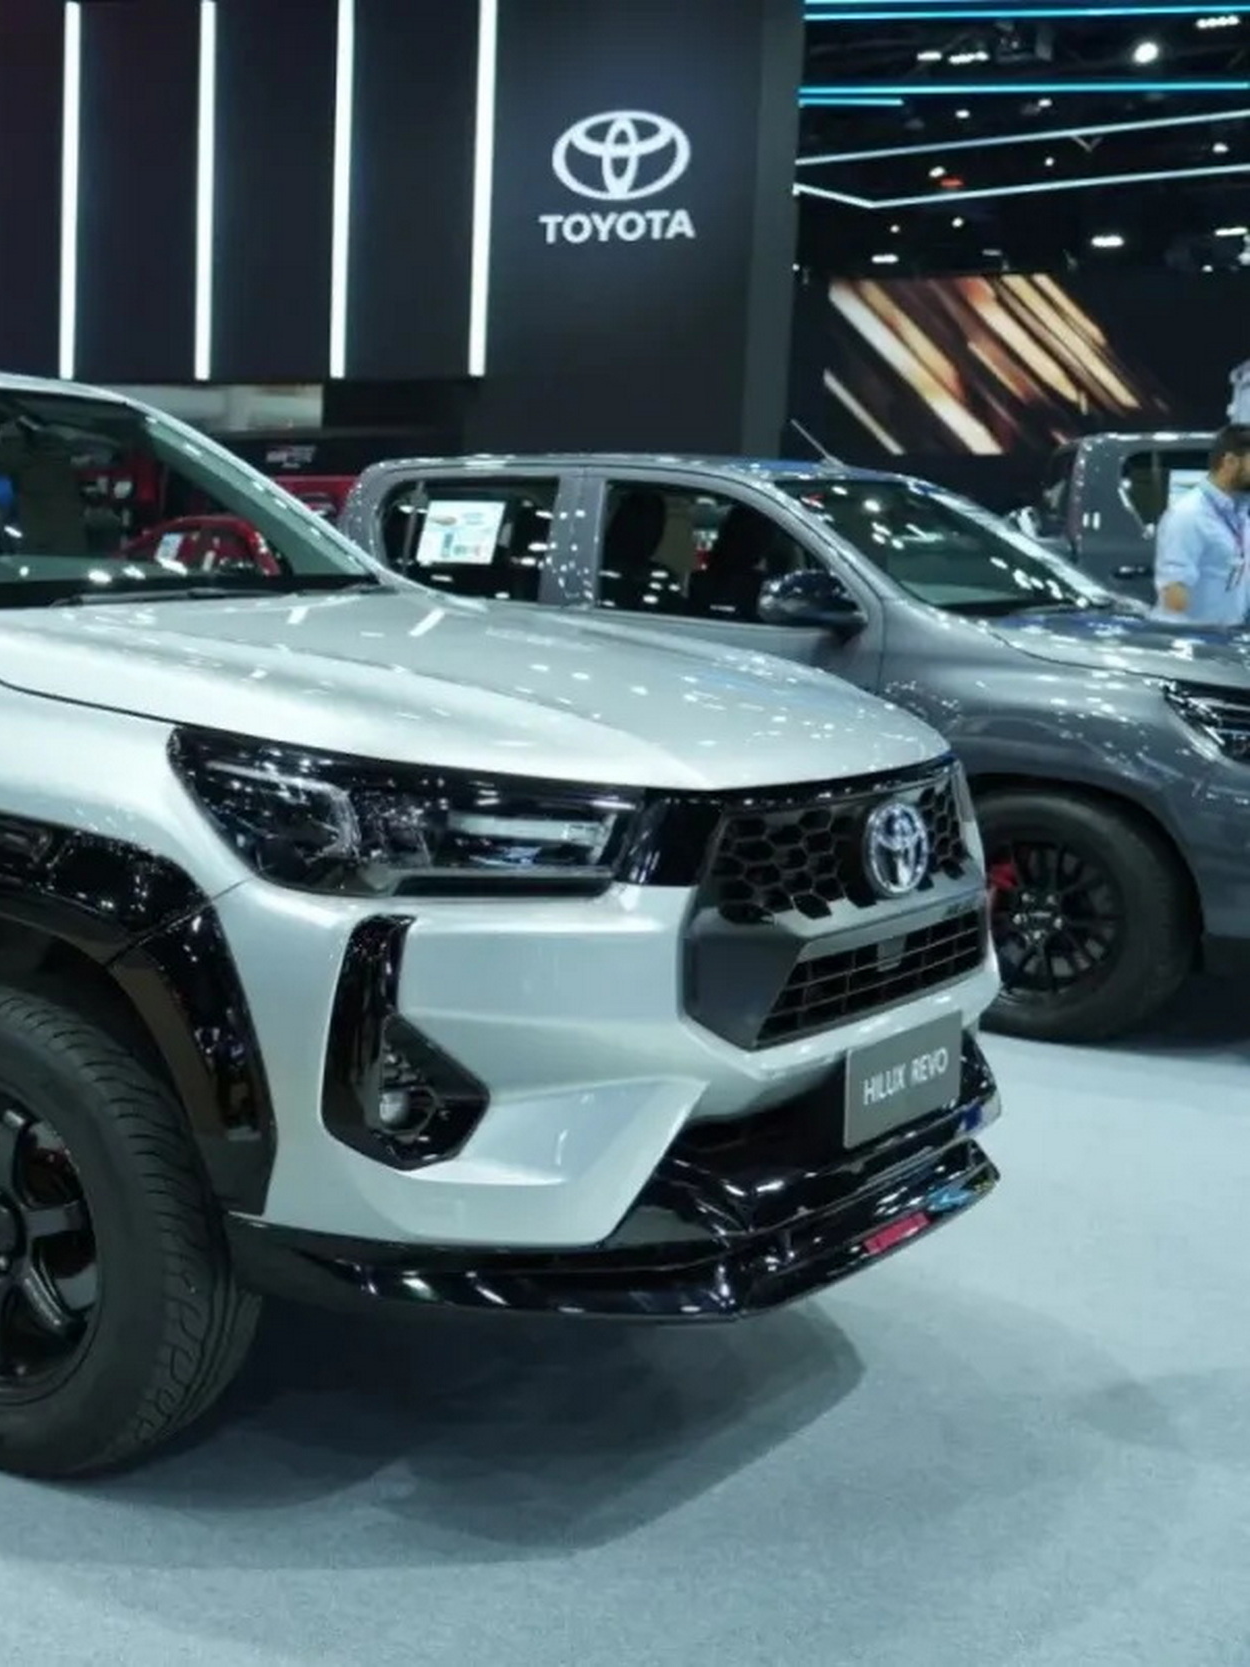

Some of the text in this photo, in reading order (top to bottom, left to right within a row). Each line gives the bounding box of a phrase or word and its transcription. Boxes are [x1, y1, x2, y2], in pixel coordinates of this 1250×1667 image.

[538, 209, 696, 244] TOYOTA
[862, 1047, 949, 1106] HILUX REVO
